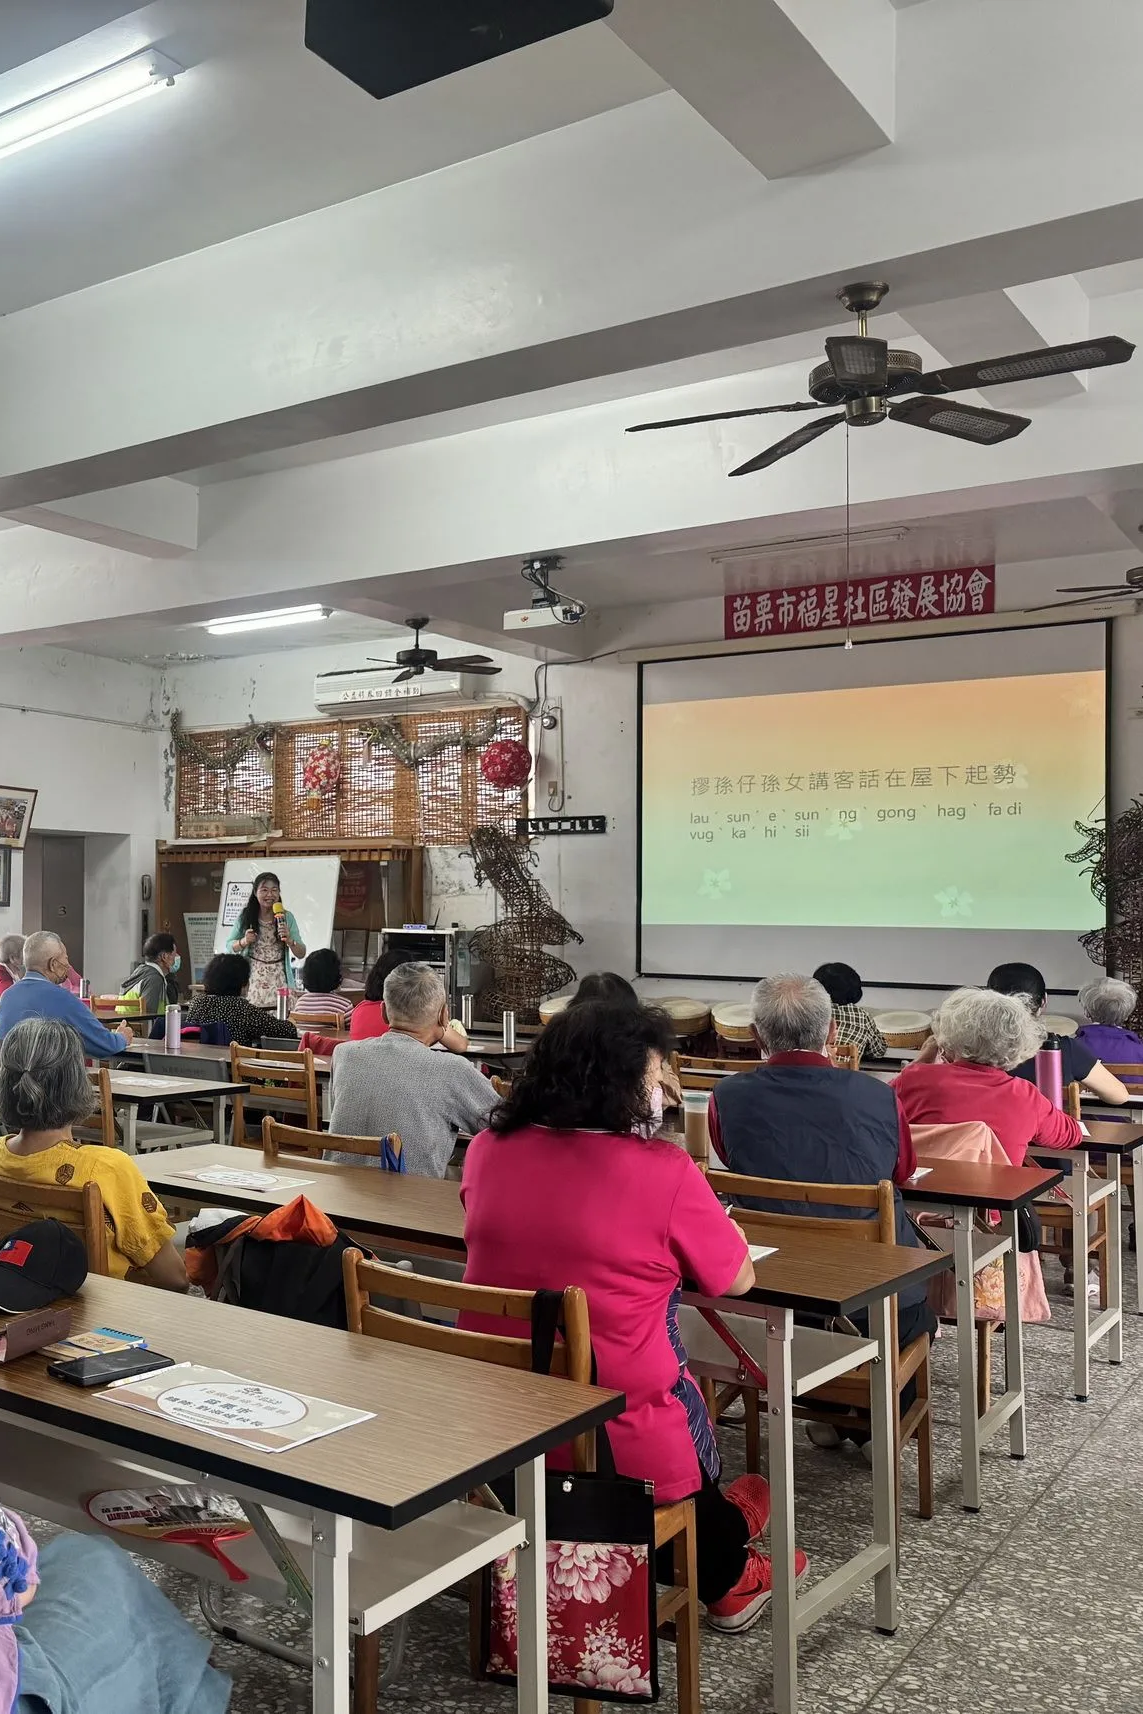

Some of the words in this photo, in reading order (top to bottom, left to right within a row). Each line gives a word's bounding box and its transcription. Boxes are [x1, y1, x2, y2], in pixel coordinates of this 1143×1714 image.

[732, 568, 992, 634] 苗栗市福星社區發展協會
[988, 802, 1002, 816] fa
[1006, 801, 1022, 816] di
[794, 825, 810, 838] sii
